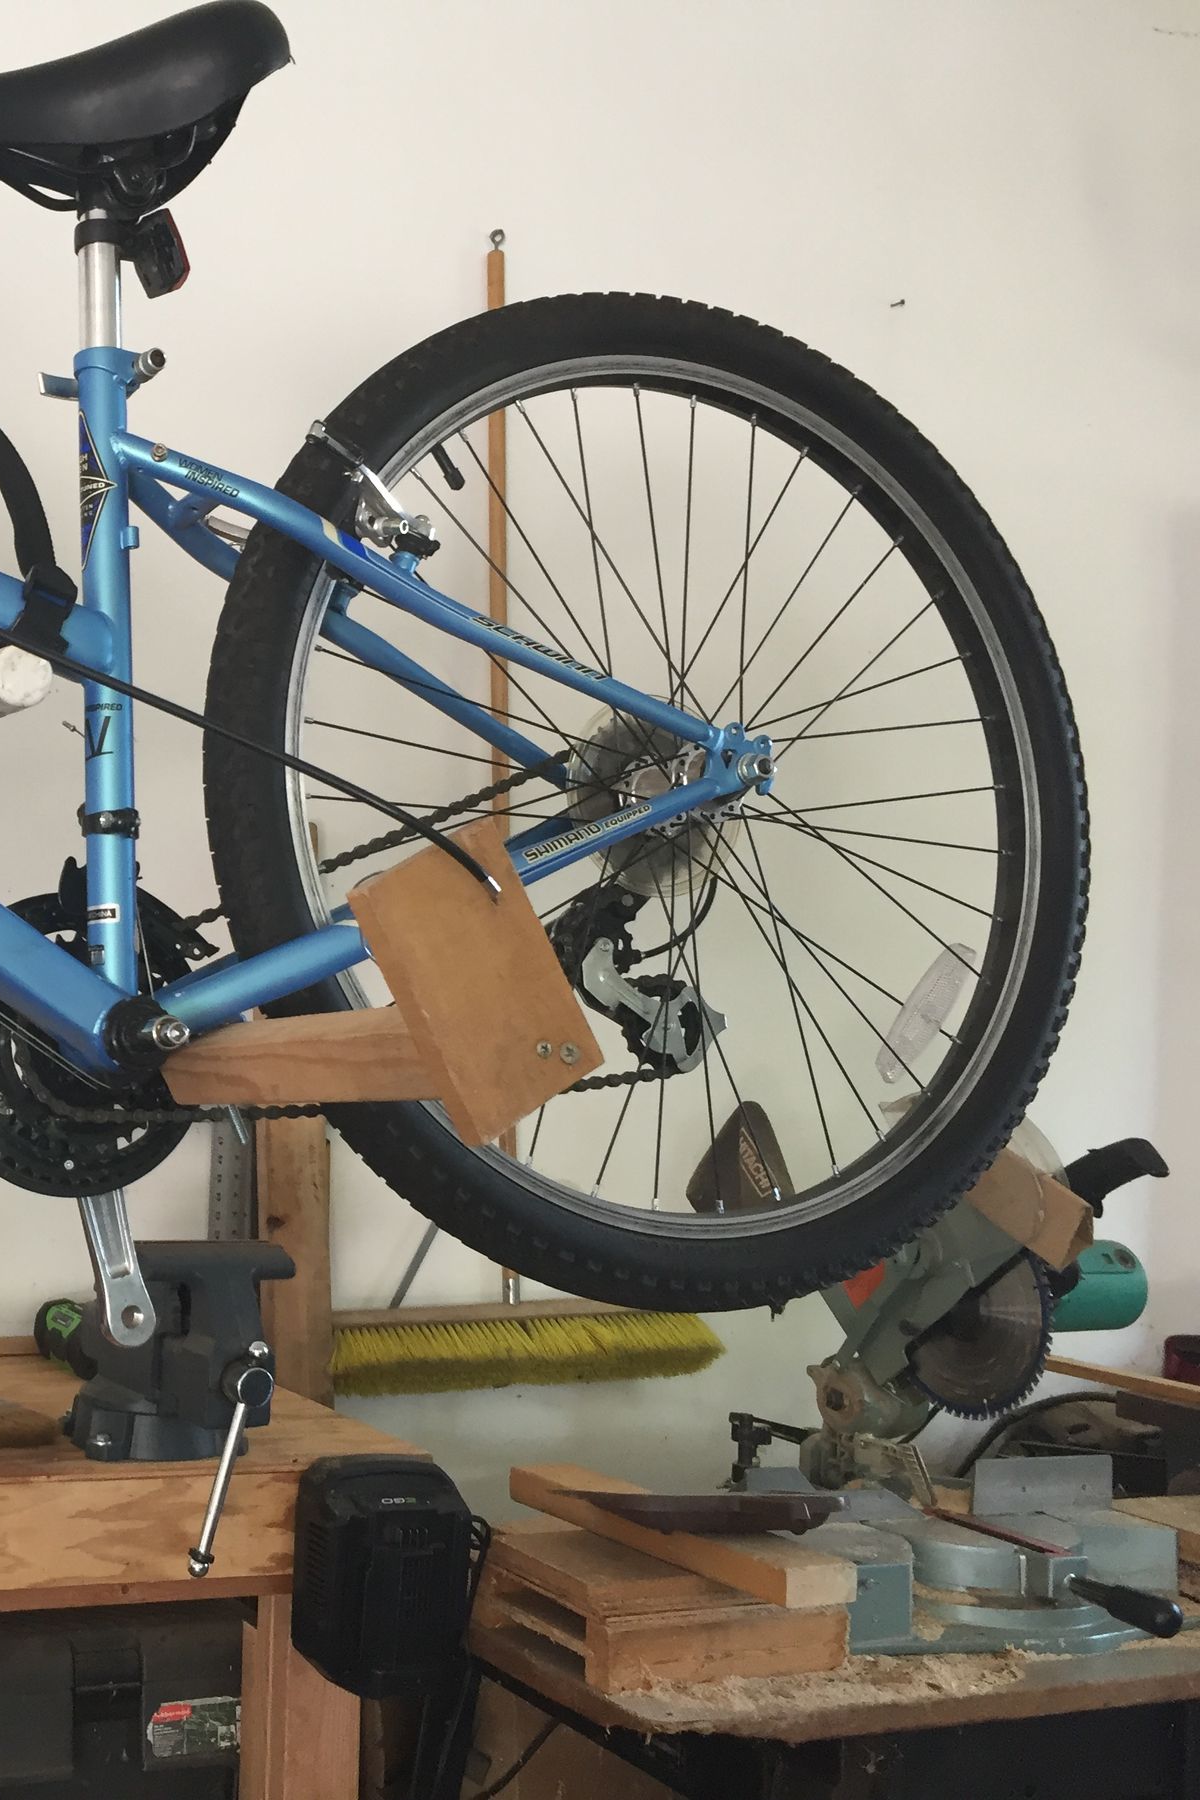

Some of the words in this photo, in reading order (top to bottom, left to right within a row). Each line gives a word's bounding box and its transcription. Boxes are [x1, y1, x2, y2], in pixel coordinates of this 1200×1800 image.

[178, 458, 223, 481] WOMEN
[184, 470, 240, 498] INSPIRED
[472, 615, 606, 680] SCHWINN
[523, 823, 601, 862] SHIMANO
[603, 804, 651, 829] EQUIPPED
[740, 1135, 771, 1189] HITACHI
